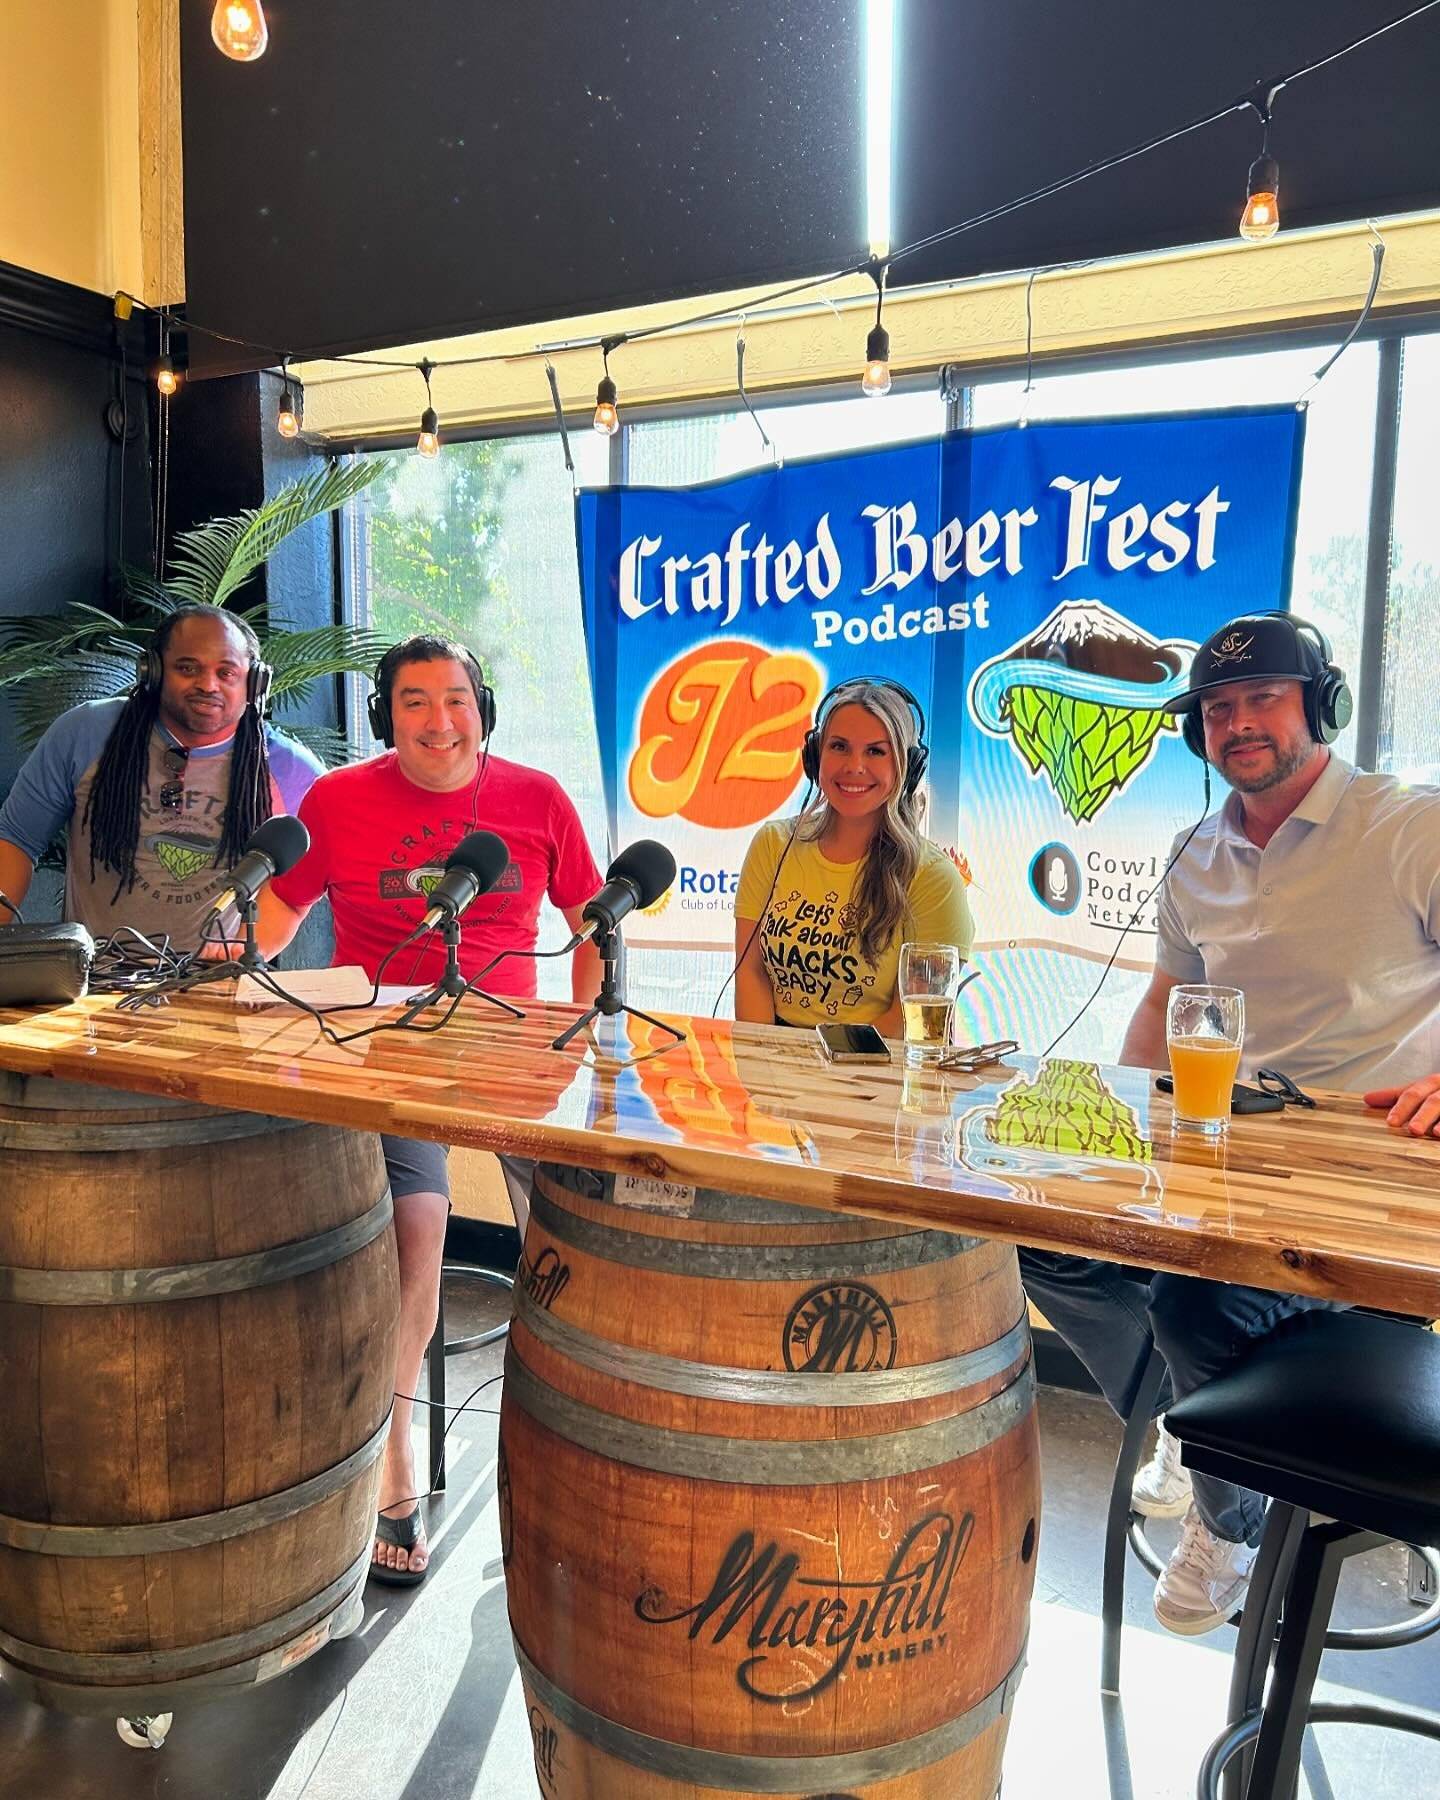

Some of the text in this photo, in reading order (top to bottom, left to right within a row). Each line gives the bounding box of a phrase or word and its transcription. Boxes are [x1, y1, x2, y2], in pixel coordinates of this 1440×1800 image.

[619, 474, 1231, 627] Crafted Beer Fest
[811, 592, 990, 648] Podcast
[681, 898, 704, 911] Club
[706, 898, 719, 910] of
[759, 931, 858, 984] SNACKS
[773, 967, 831, 1003] BABY
[634, 1511, 976, 1704] Maryhill
[854, 1632, 949, 1670] WINERY
